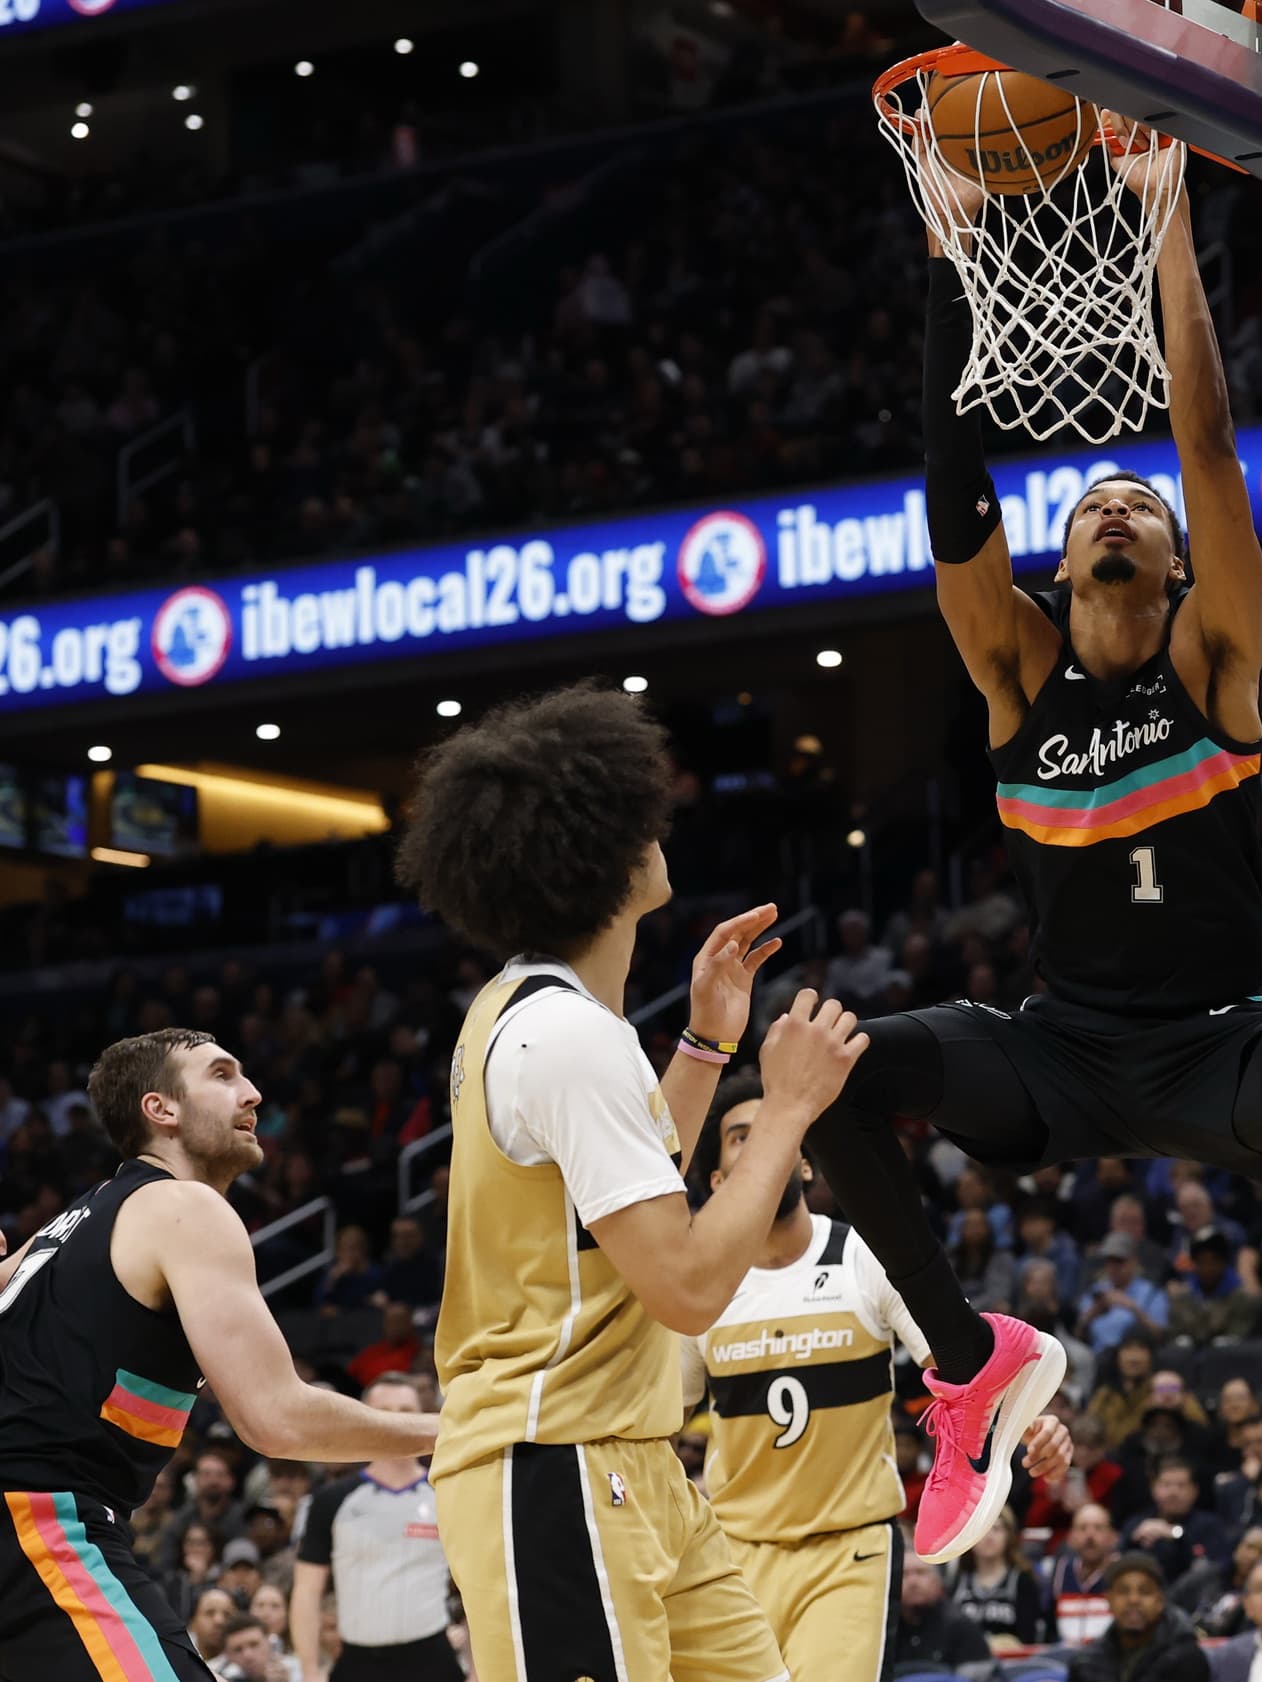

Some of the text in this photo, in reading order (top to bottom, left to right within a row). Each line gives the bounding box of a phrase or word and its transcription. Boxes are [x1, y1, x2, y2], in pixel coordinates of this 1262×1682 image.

[965, 130, 1078, 173] Wilson
[241, 539, 667, 661] ibewlocal26.org
[0, 615, 142, 696] 6.org
[1129, 846, 1164, 904] 1
[712, 1327, 853, 1364] washington
[766, 1374, 810, 1450] 9
